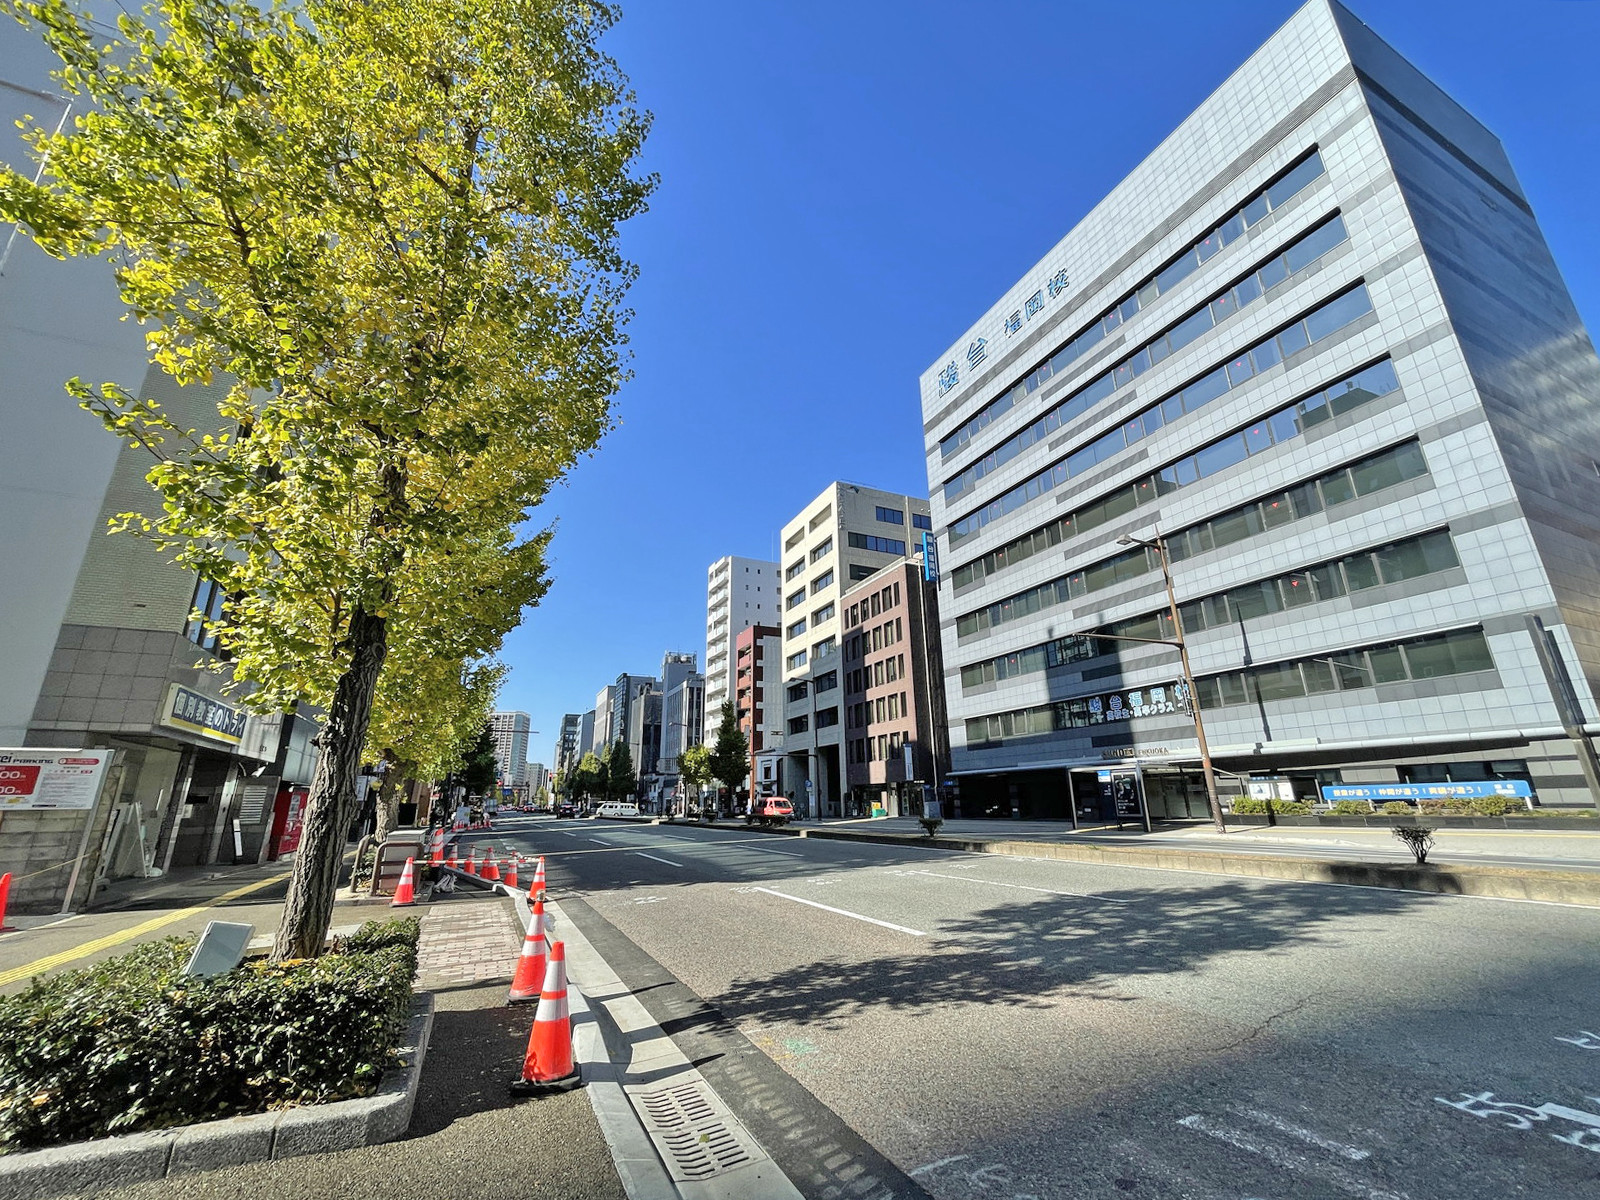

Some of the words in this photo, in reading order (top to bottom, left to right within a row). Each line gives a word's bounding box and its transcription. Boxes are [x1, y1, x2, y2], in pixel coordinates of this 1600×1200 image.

[174, 691, 246, 735] 個別教室のトライ
